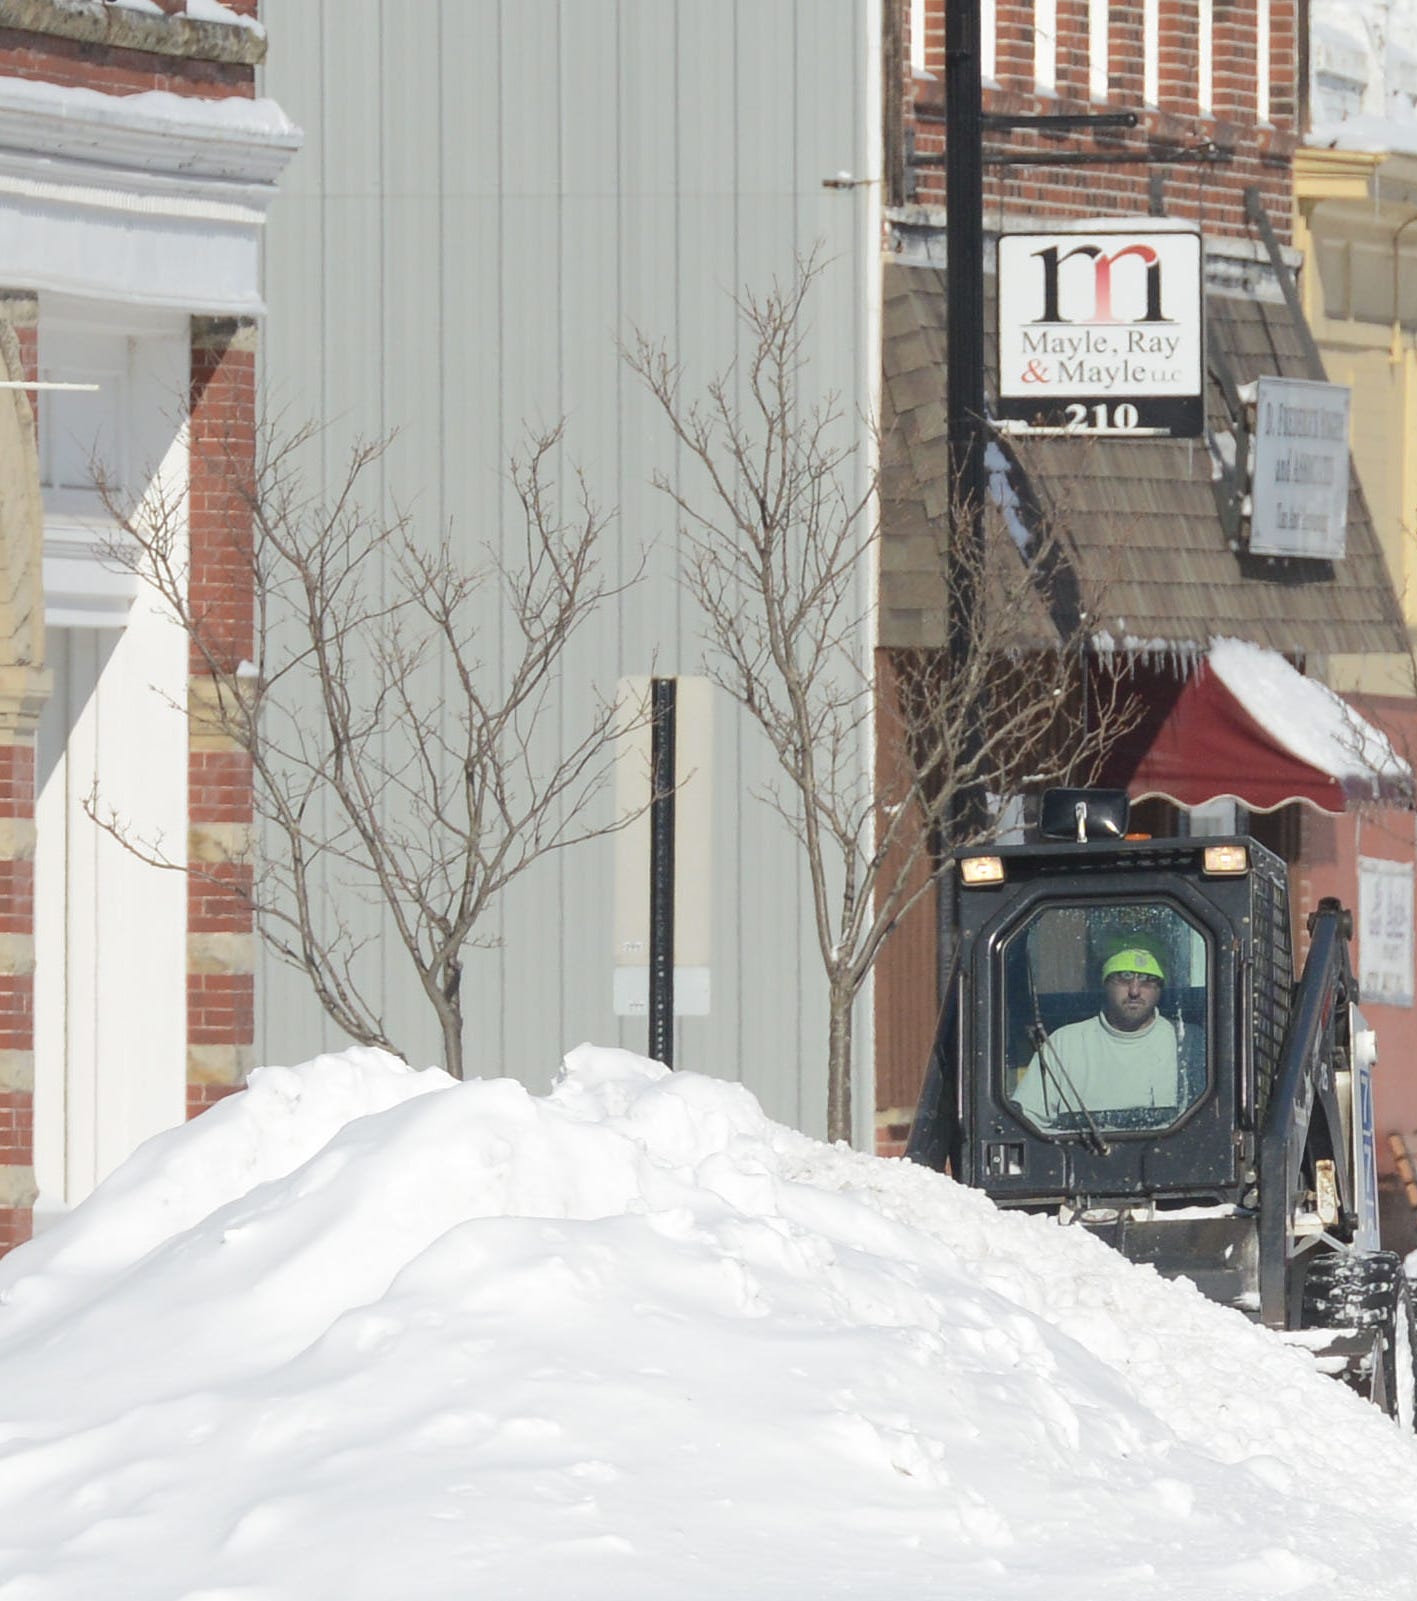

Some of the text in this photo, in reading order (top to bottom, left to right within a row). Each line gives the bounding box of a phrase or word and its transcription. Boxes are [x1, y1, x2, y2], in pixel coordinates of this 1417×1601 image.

[1021, 330, 1181, 361] Mayle, Ray
[1020, 358, 1051, 384] &
[1057, 359, 1146, 389] Mayle
[1064, 402, 1139, 429] 210
